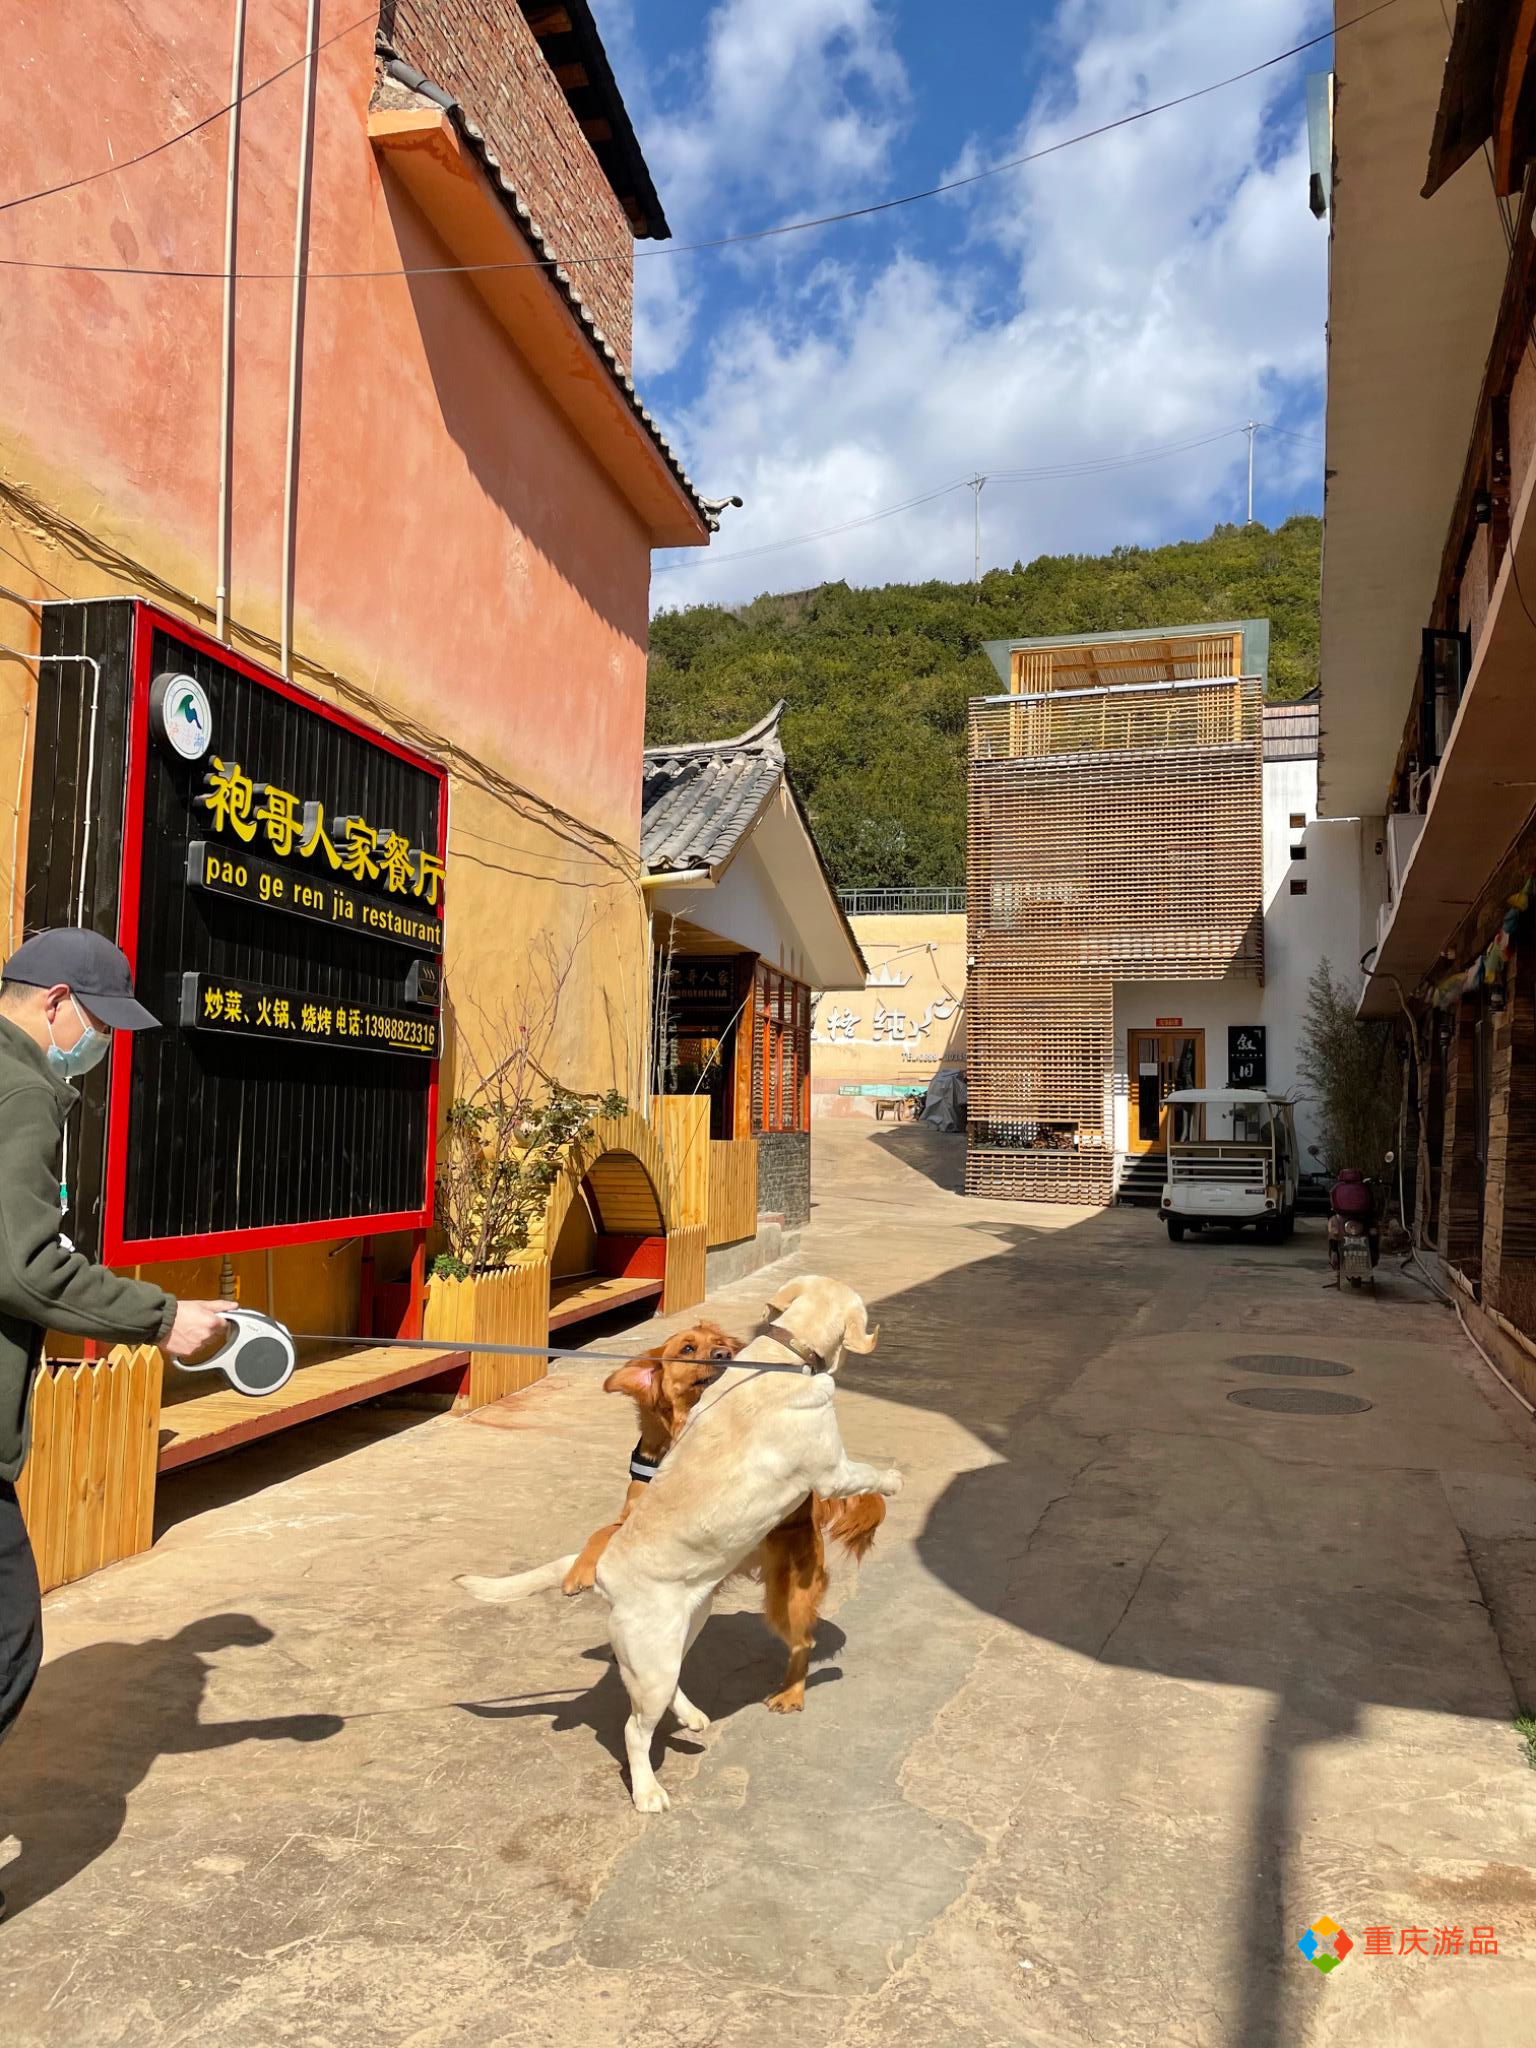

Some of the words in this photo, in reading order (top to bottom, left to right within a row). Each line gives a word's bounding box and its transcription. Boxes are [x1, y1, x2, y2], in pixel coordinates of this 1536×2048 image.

[206, 757, 446, 905] 袍哥人家餐厅
[206, 856, 248, 887] pao
[259, 873, 284, 901] ge
[294, 883, 324, 910] ren
[332, 889, 354, 920] jia
[362, 905, 442, 945] restaurant
[204, 987, 333, 1036] 炒菜、火锅、烧烤
[335, 1006, 436, 1046] 电话:13988823316
